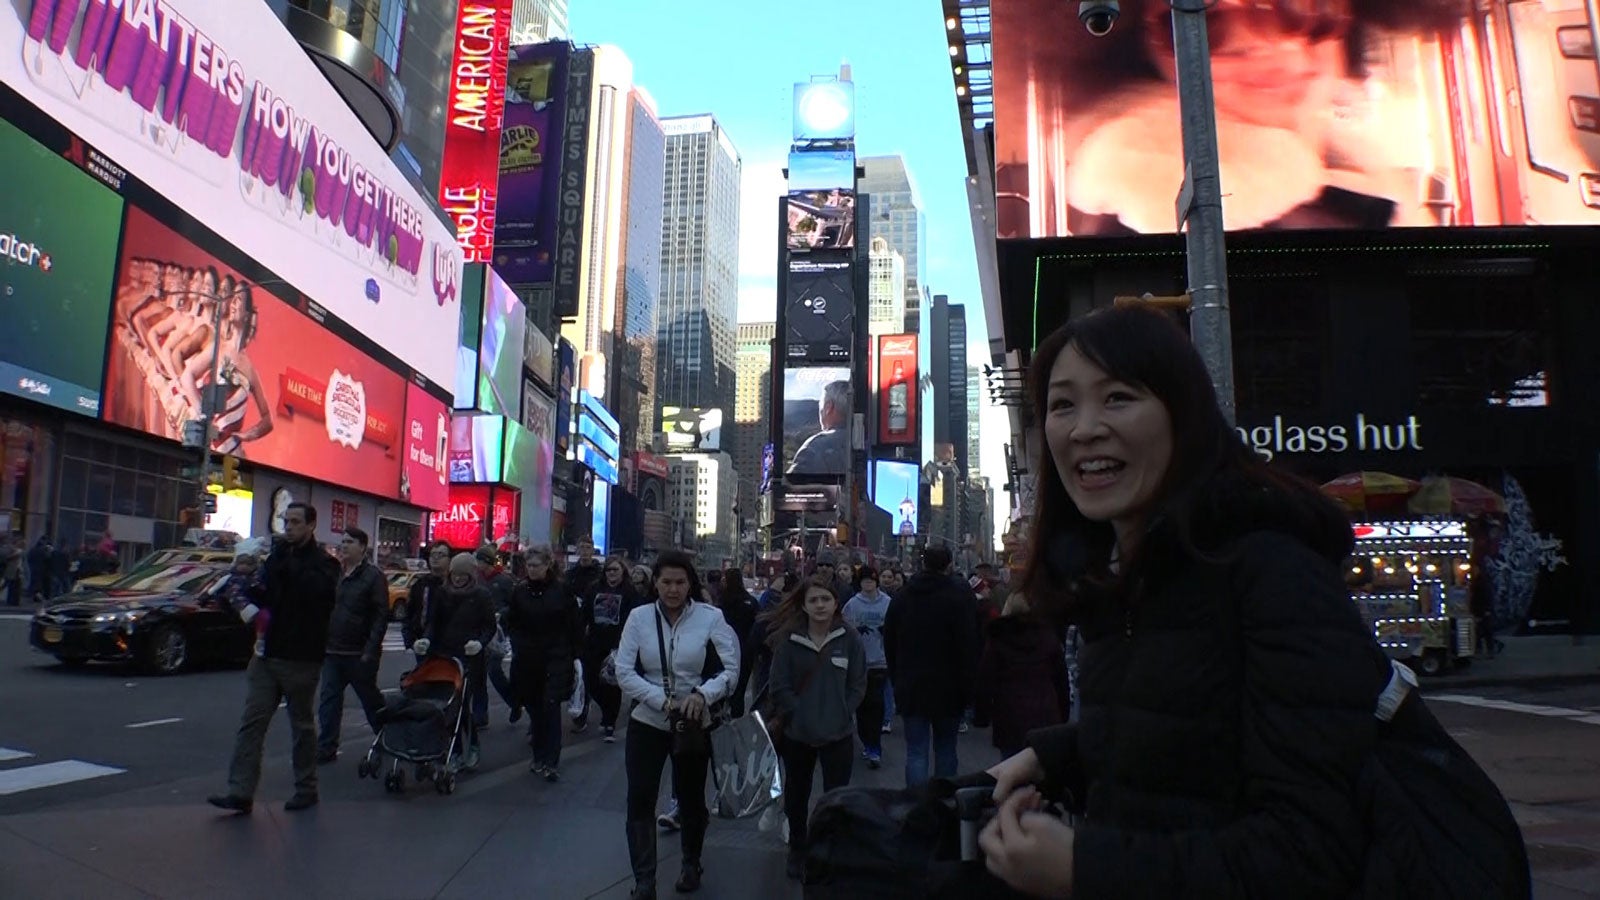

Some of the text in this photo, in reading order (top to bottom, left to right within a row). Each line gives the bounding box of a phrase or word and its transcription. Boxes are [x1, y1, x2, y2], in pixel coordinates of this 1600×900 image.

[453, 4, 497, 132] AMERICAN
[87, 162, 121, 189] MARQUIS
[89, 150, 127, 180] MARRIOTT
[253, 79, 308, 152] HOW
[313, 128, 352, 186] YOU
[352, 162, 384, 213] GET
[381, 187, 423, 240] THERE
[560, 72, 588, 285] TIMES SQUARE
[444, 187, 480, 263] EAGLE
[287, 378, 323, 405] MAKE TIME
[411, 419, 423, 441] Gift
[1357, 412, 1425, 452] hut
